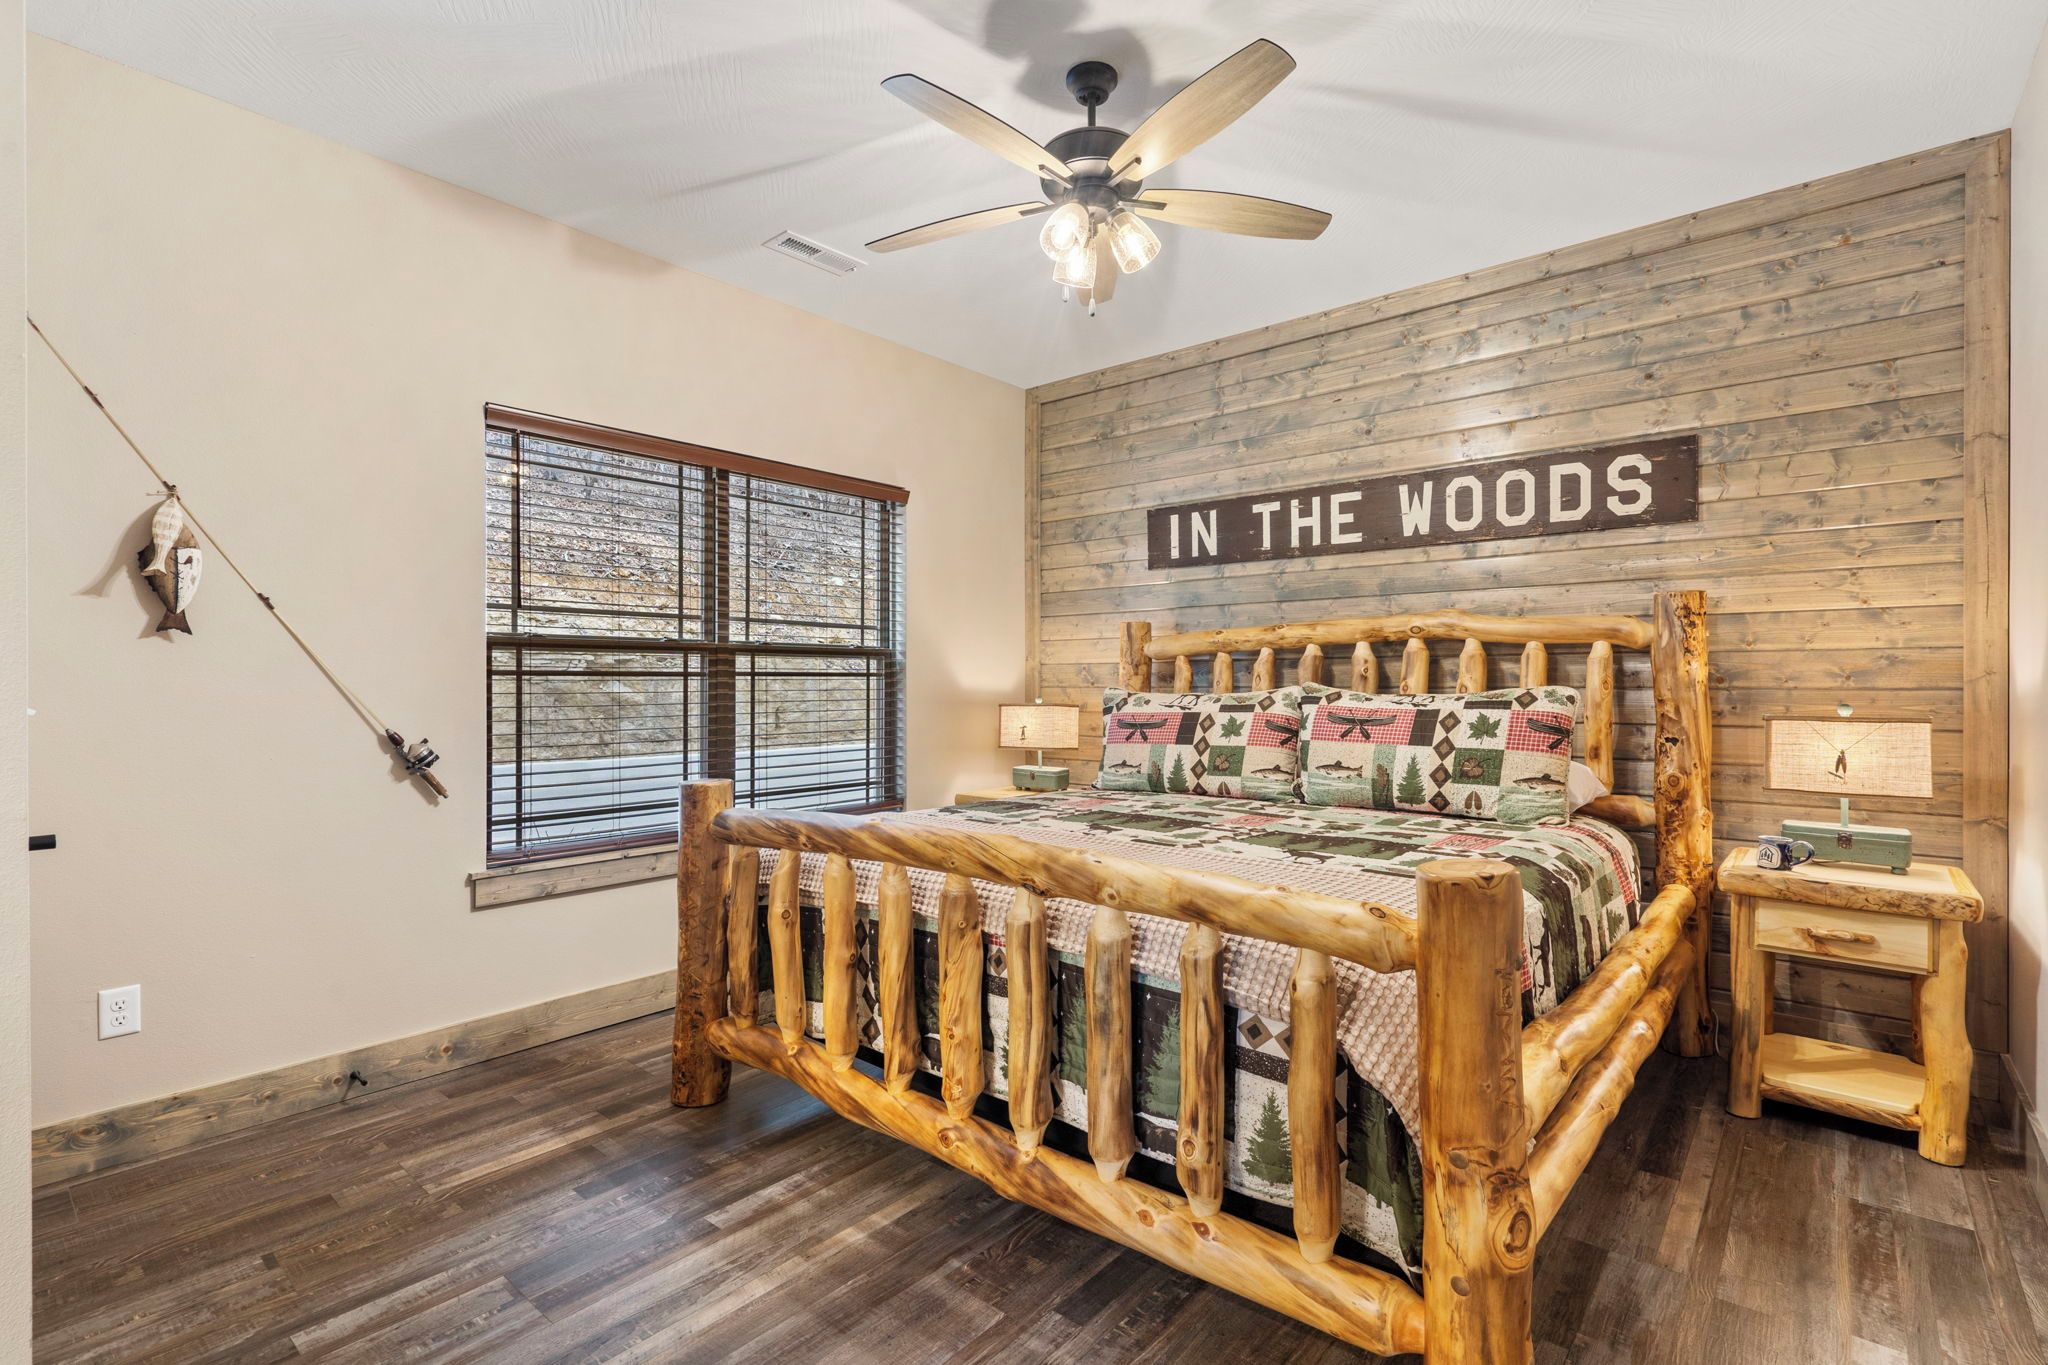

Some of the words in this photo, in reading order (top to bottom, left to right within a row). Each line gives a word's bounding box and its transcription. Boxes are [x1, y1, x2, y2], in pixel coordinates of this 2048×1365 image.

[1169, 509, 1217, 559] IN
[1252, 490, 1362, 550] THE
[1399, 453, 1653, 536] WOODS
